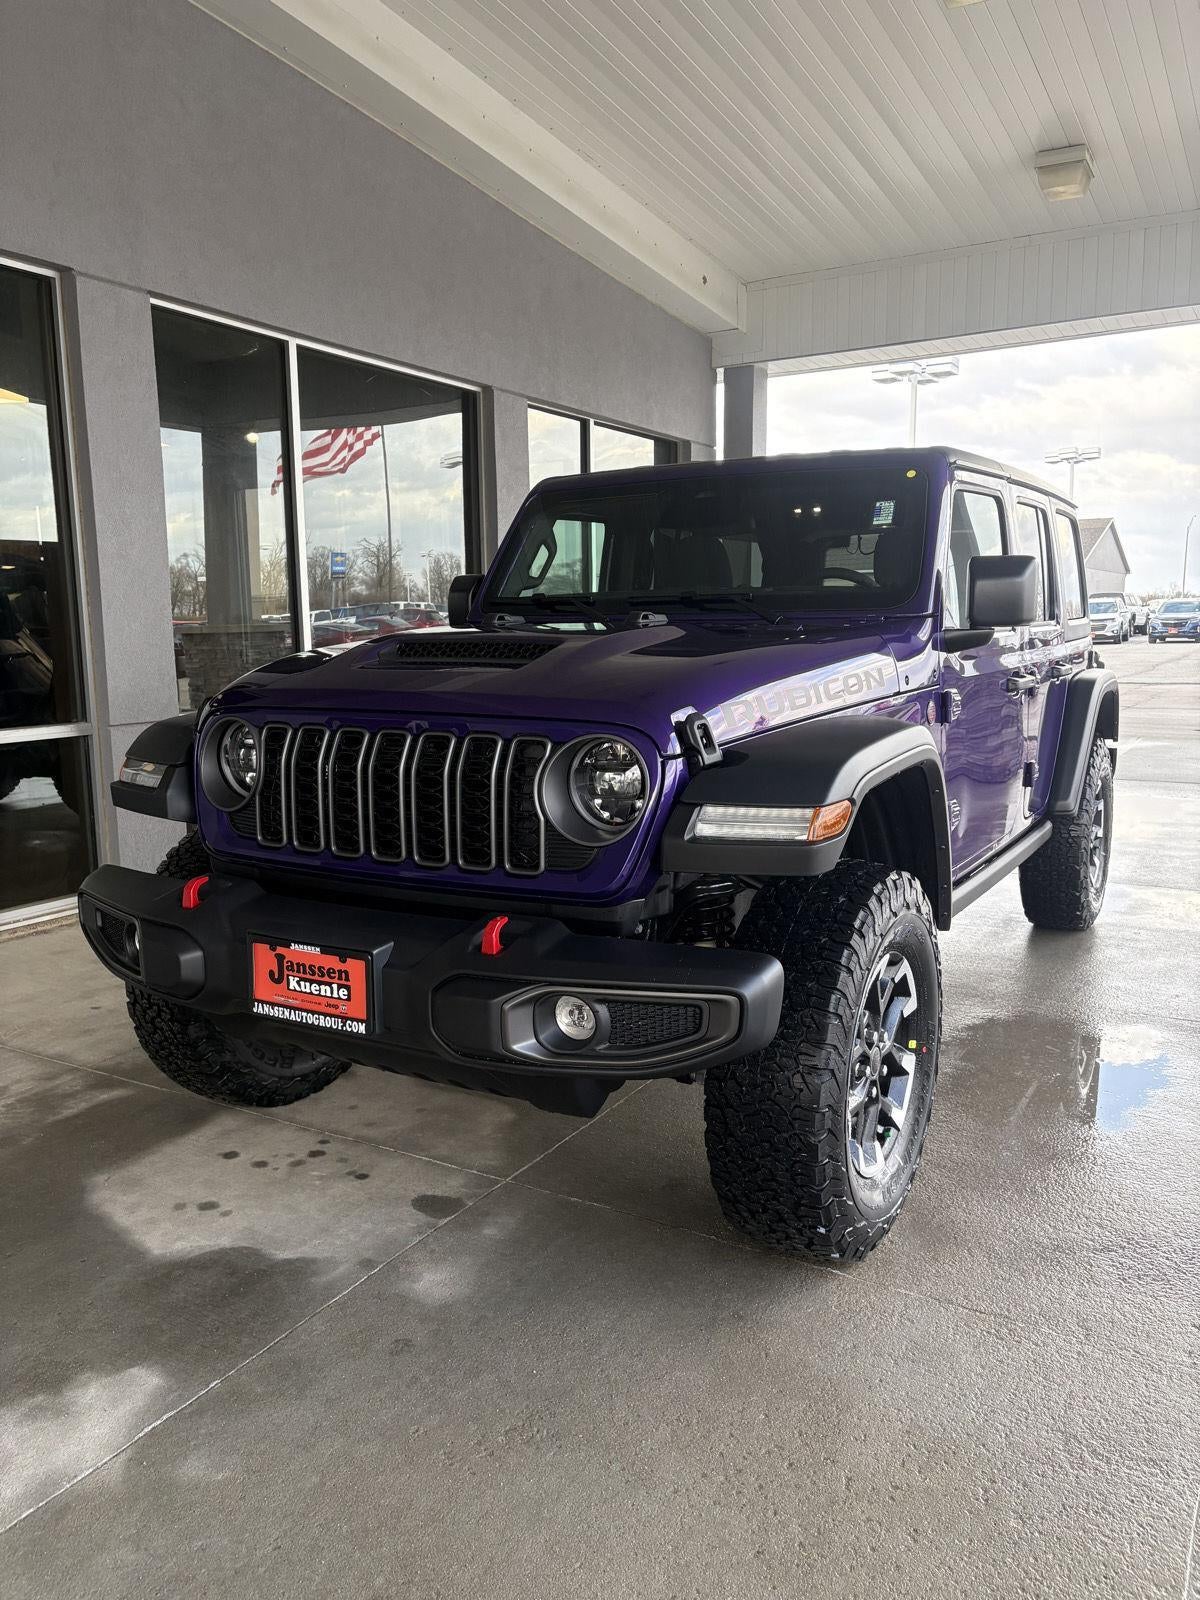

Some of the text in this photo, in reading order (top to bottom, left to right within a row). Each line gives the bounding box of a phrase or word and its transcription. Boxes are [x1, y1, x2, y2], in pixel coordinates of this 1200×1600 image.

[719, 667, 886, 728] RUBICON
[289, 942, 321, 953] JANSSEN
[268, 953, 351, 985] Janssen
[288, 976, 348, 1000] Kuenle
